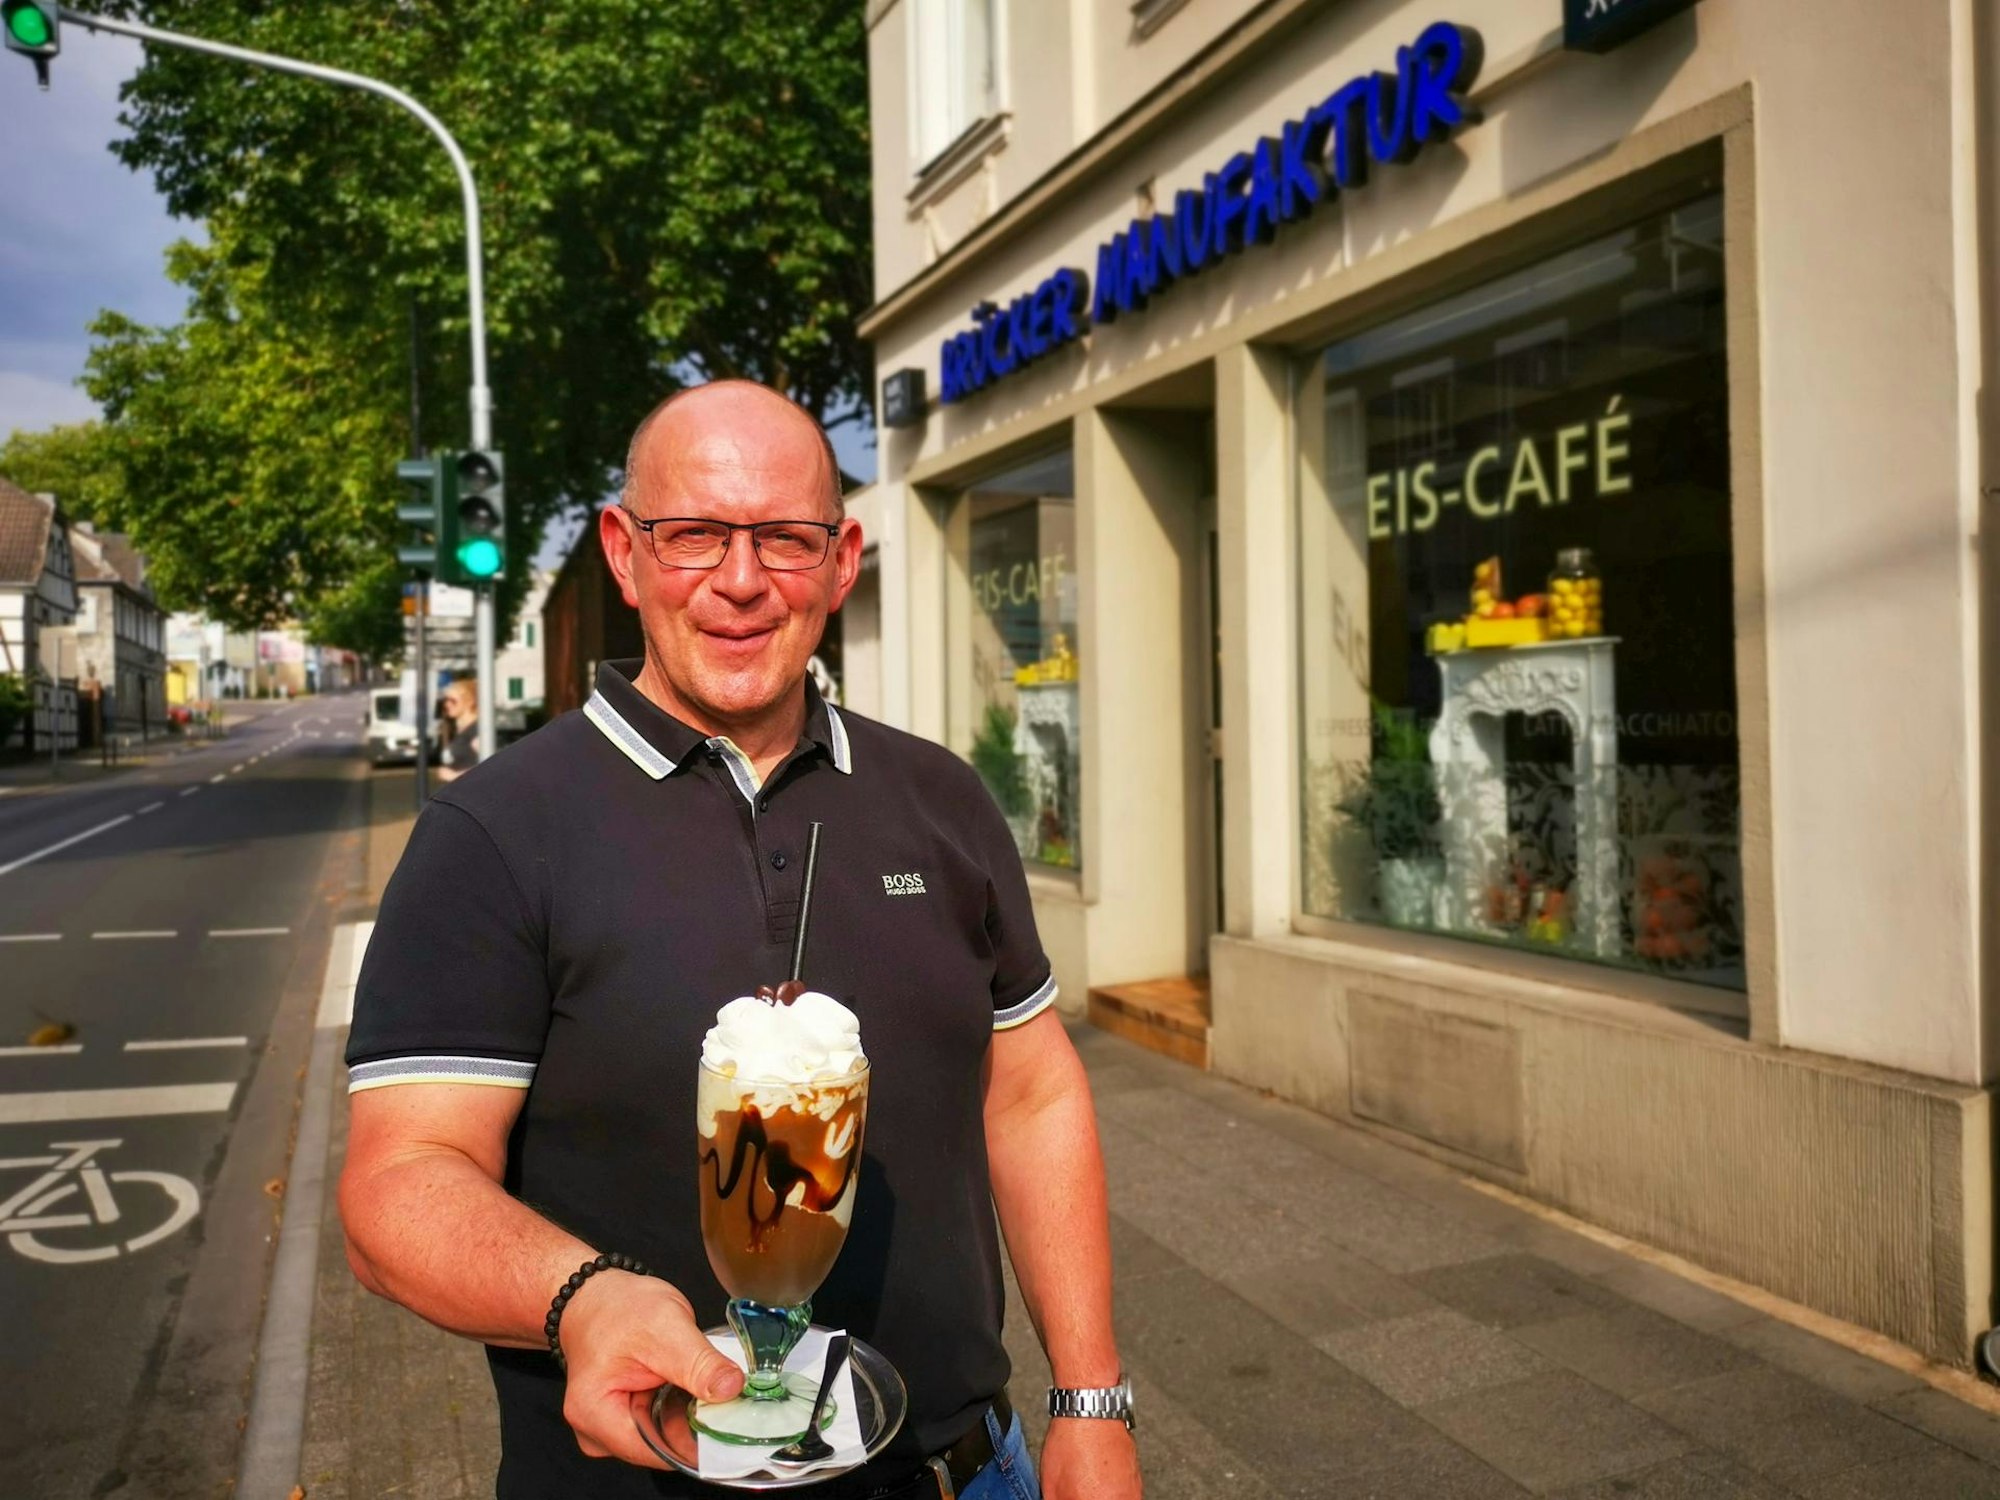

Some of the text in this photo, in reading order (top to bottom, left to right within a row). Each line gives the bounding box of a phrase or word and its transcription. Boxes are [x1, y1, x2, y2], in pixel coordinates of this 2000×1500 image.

[941, 21, 1470, 404] BRÜCKER MANUFAKTUR
[1367, 394, 1632, 540] EIS-CAFÉ
[1523, 713, 1570, 738] LATT
[882, 873, 924, 889] BOSS
